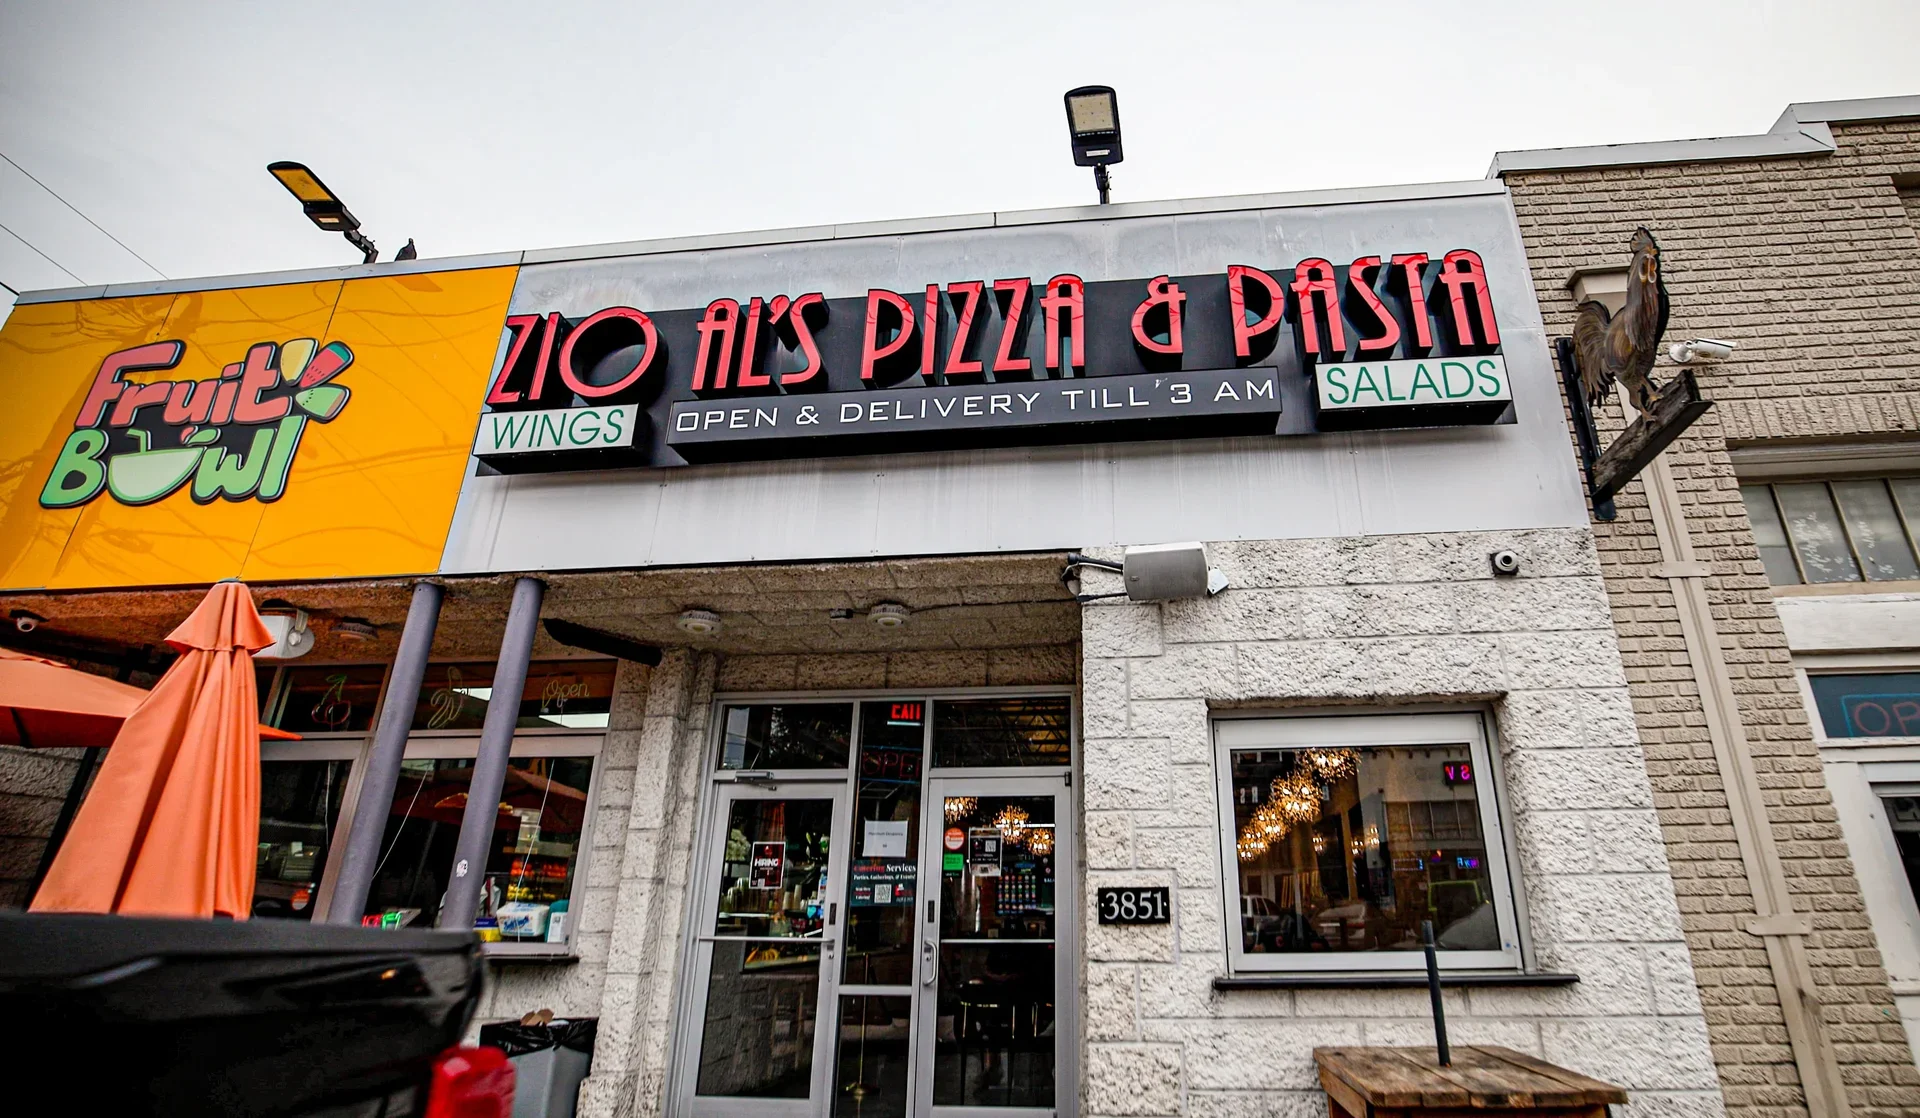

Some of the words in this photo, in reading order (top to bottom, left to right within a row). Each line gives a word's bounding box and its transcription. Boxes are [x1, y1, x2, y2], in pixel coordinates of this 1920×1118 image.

[486, 306, 659, 404] ZIO
[691, 292, 824, 391] AL'S
[860, 273, 1086, 379] PIZZA
[1130, 274, 1187, 354] &
[1227, 248, 1501, 357] PASTA
[74, 339, 294, 428] Fruit
[1326, 359, 1501, 405] SALADS
[676, 406, 778, 432] OPEN
[795, 405, 820, 425] &
[839, 391, 1041, 423] DELIVERY
[1170, 383, 1192, 405] 3
[1213, 379, 1275, 402] AM
[492, 408, 625, 450] WINGS
[542, 679, 590, 708] Open
[891, 703, 921, 720] EXIT
[754, 858, 779, 867] HIRING
[886, 863, 917, 872] Services
[1104, 890, 1166, 920] 3851
